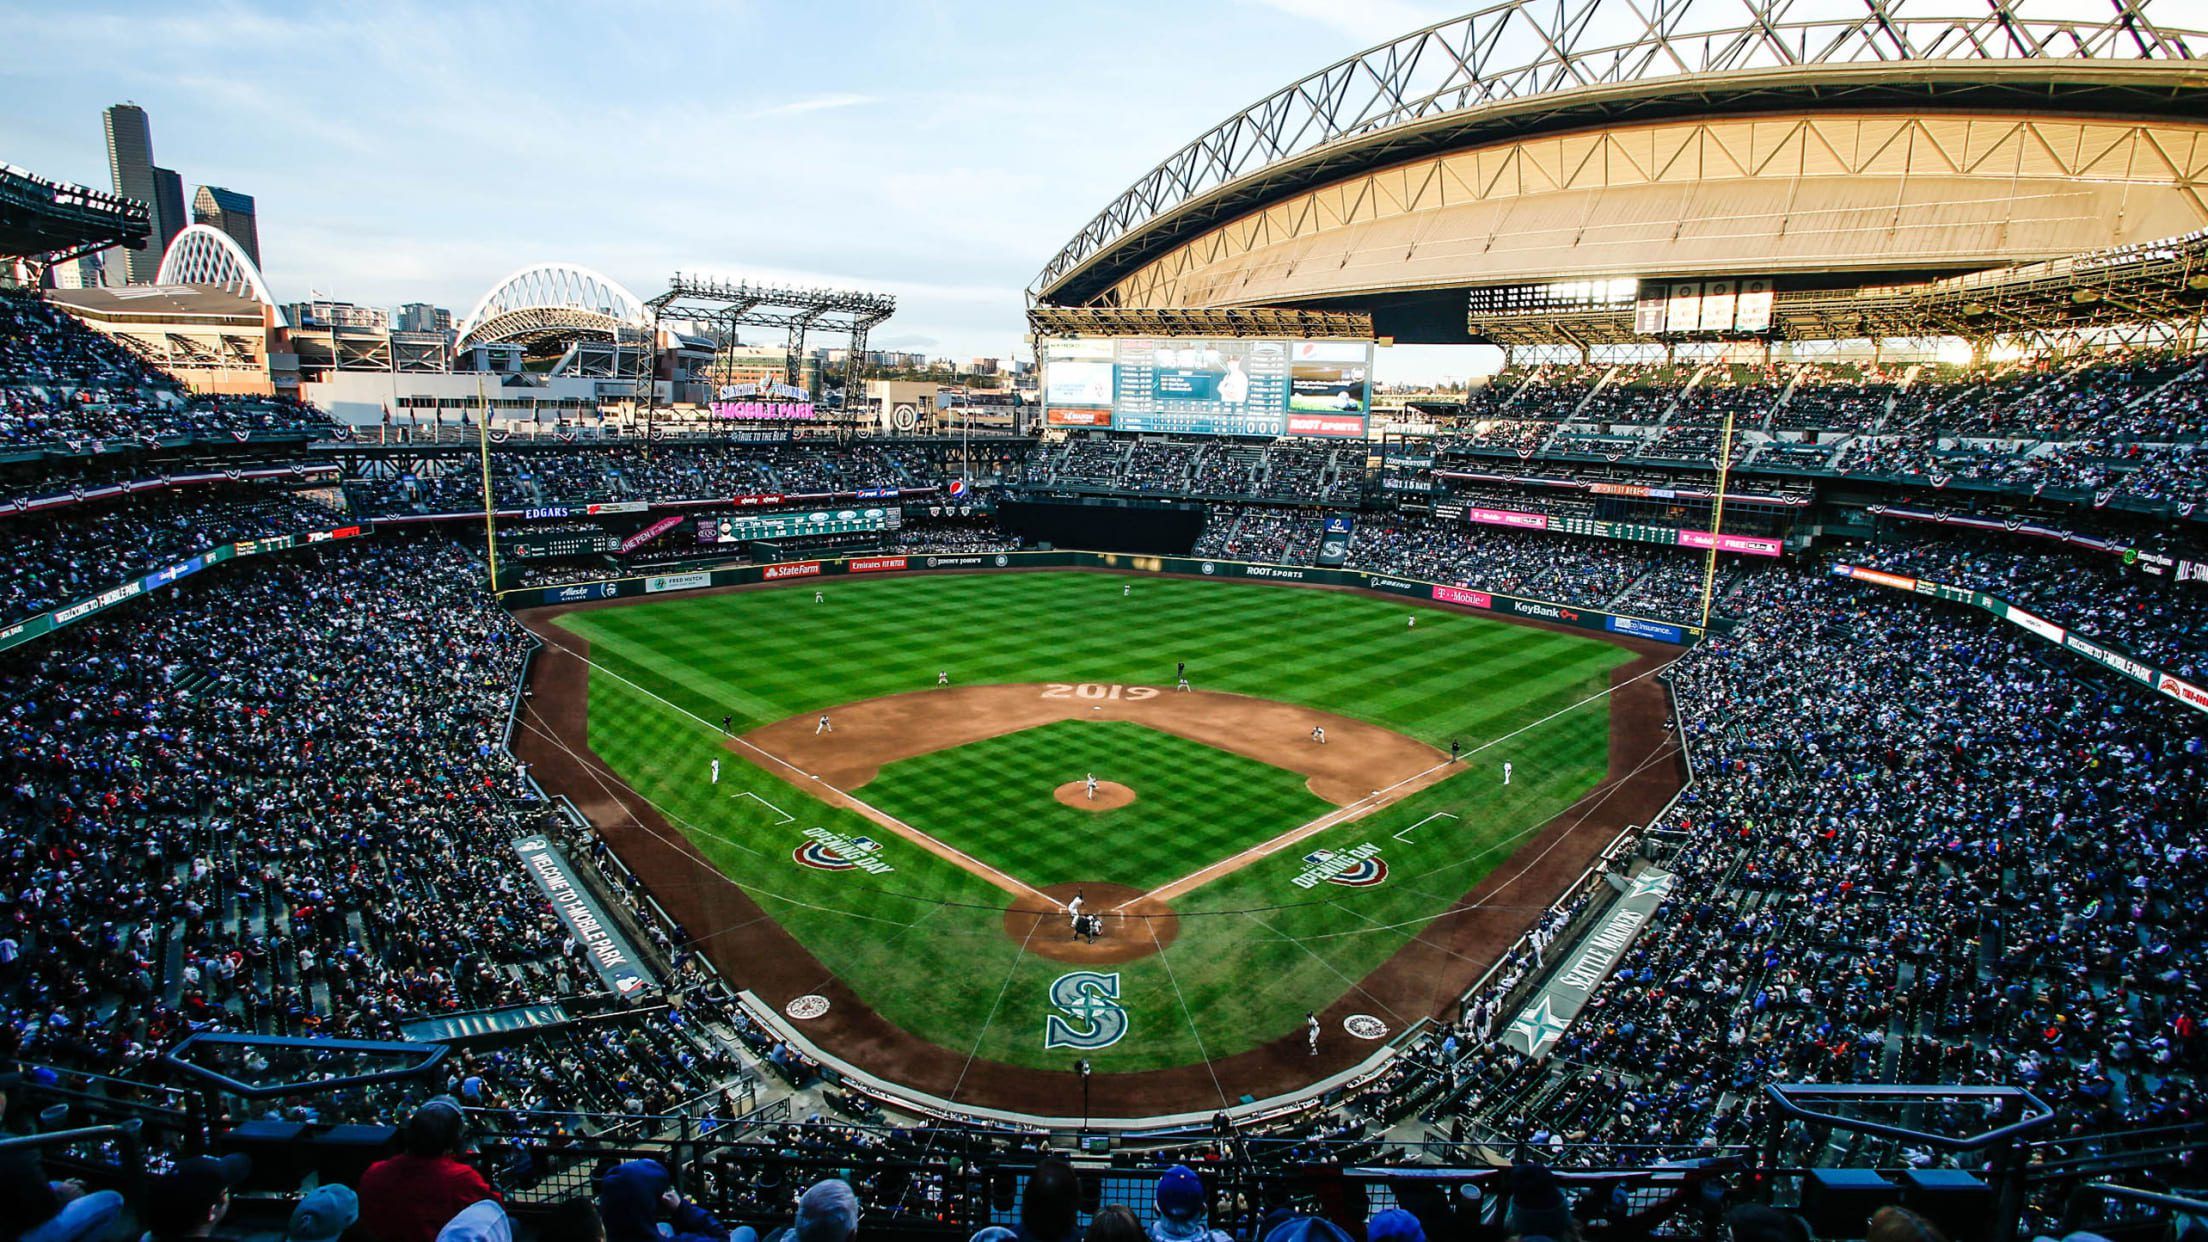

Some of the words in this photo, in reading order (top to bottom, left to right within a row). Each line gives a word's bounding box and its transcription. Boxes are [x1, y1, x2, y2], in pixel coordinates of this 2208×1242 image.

[778, 402, 817, 420] PARK
[737, 430, 753, 441] TRUE
[753, 430, 762, 441] TO
[762, 430, 773, 441] THE
[772, 429, 788, 441] BLUE
[852, 560, 881, 570] Emirates
[937, 558, 959, 566] JIMMY
[1246, 566, 1272, 576] ROOT
[1272, 569, 1304, 579] SPORTS
[1514, 601, 1560, 618] KeyBank
[1040, 683, 1160, 701] 2019
[801, 826, 868, 860] OPENING
[853, 856, 896, 875] DAY
[529, 852, 571, 892] WELCOME
[1290, 854, 1361, 889] OPENING
[1347, 842, 1383, 860] DAY
[555, 889, 579, 903] TO
[563, 898, 608, 942] T-MOBILE
[590, 935, 628, 969] PARK
[1558, 948, 1614, 992] SEATTLE
[1590, 907, 1646, 959] MARINERS
